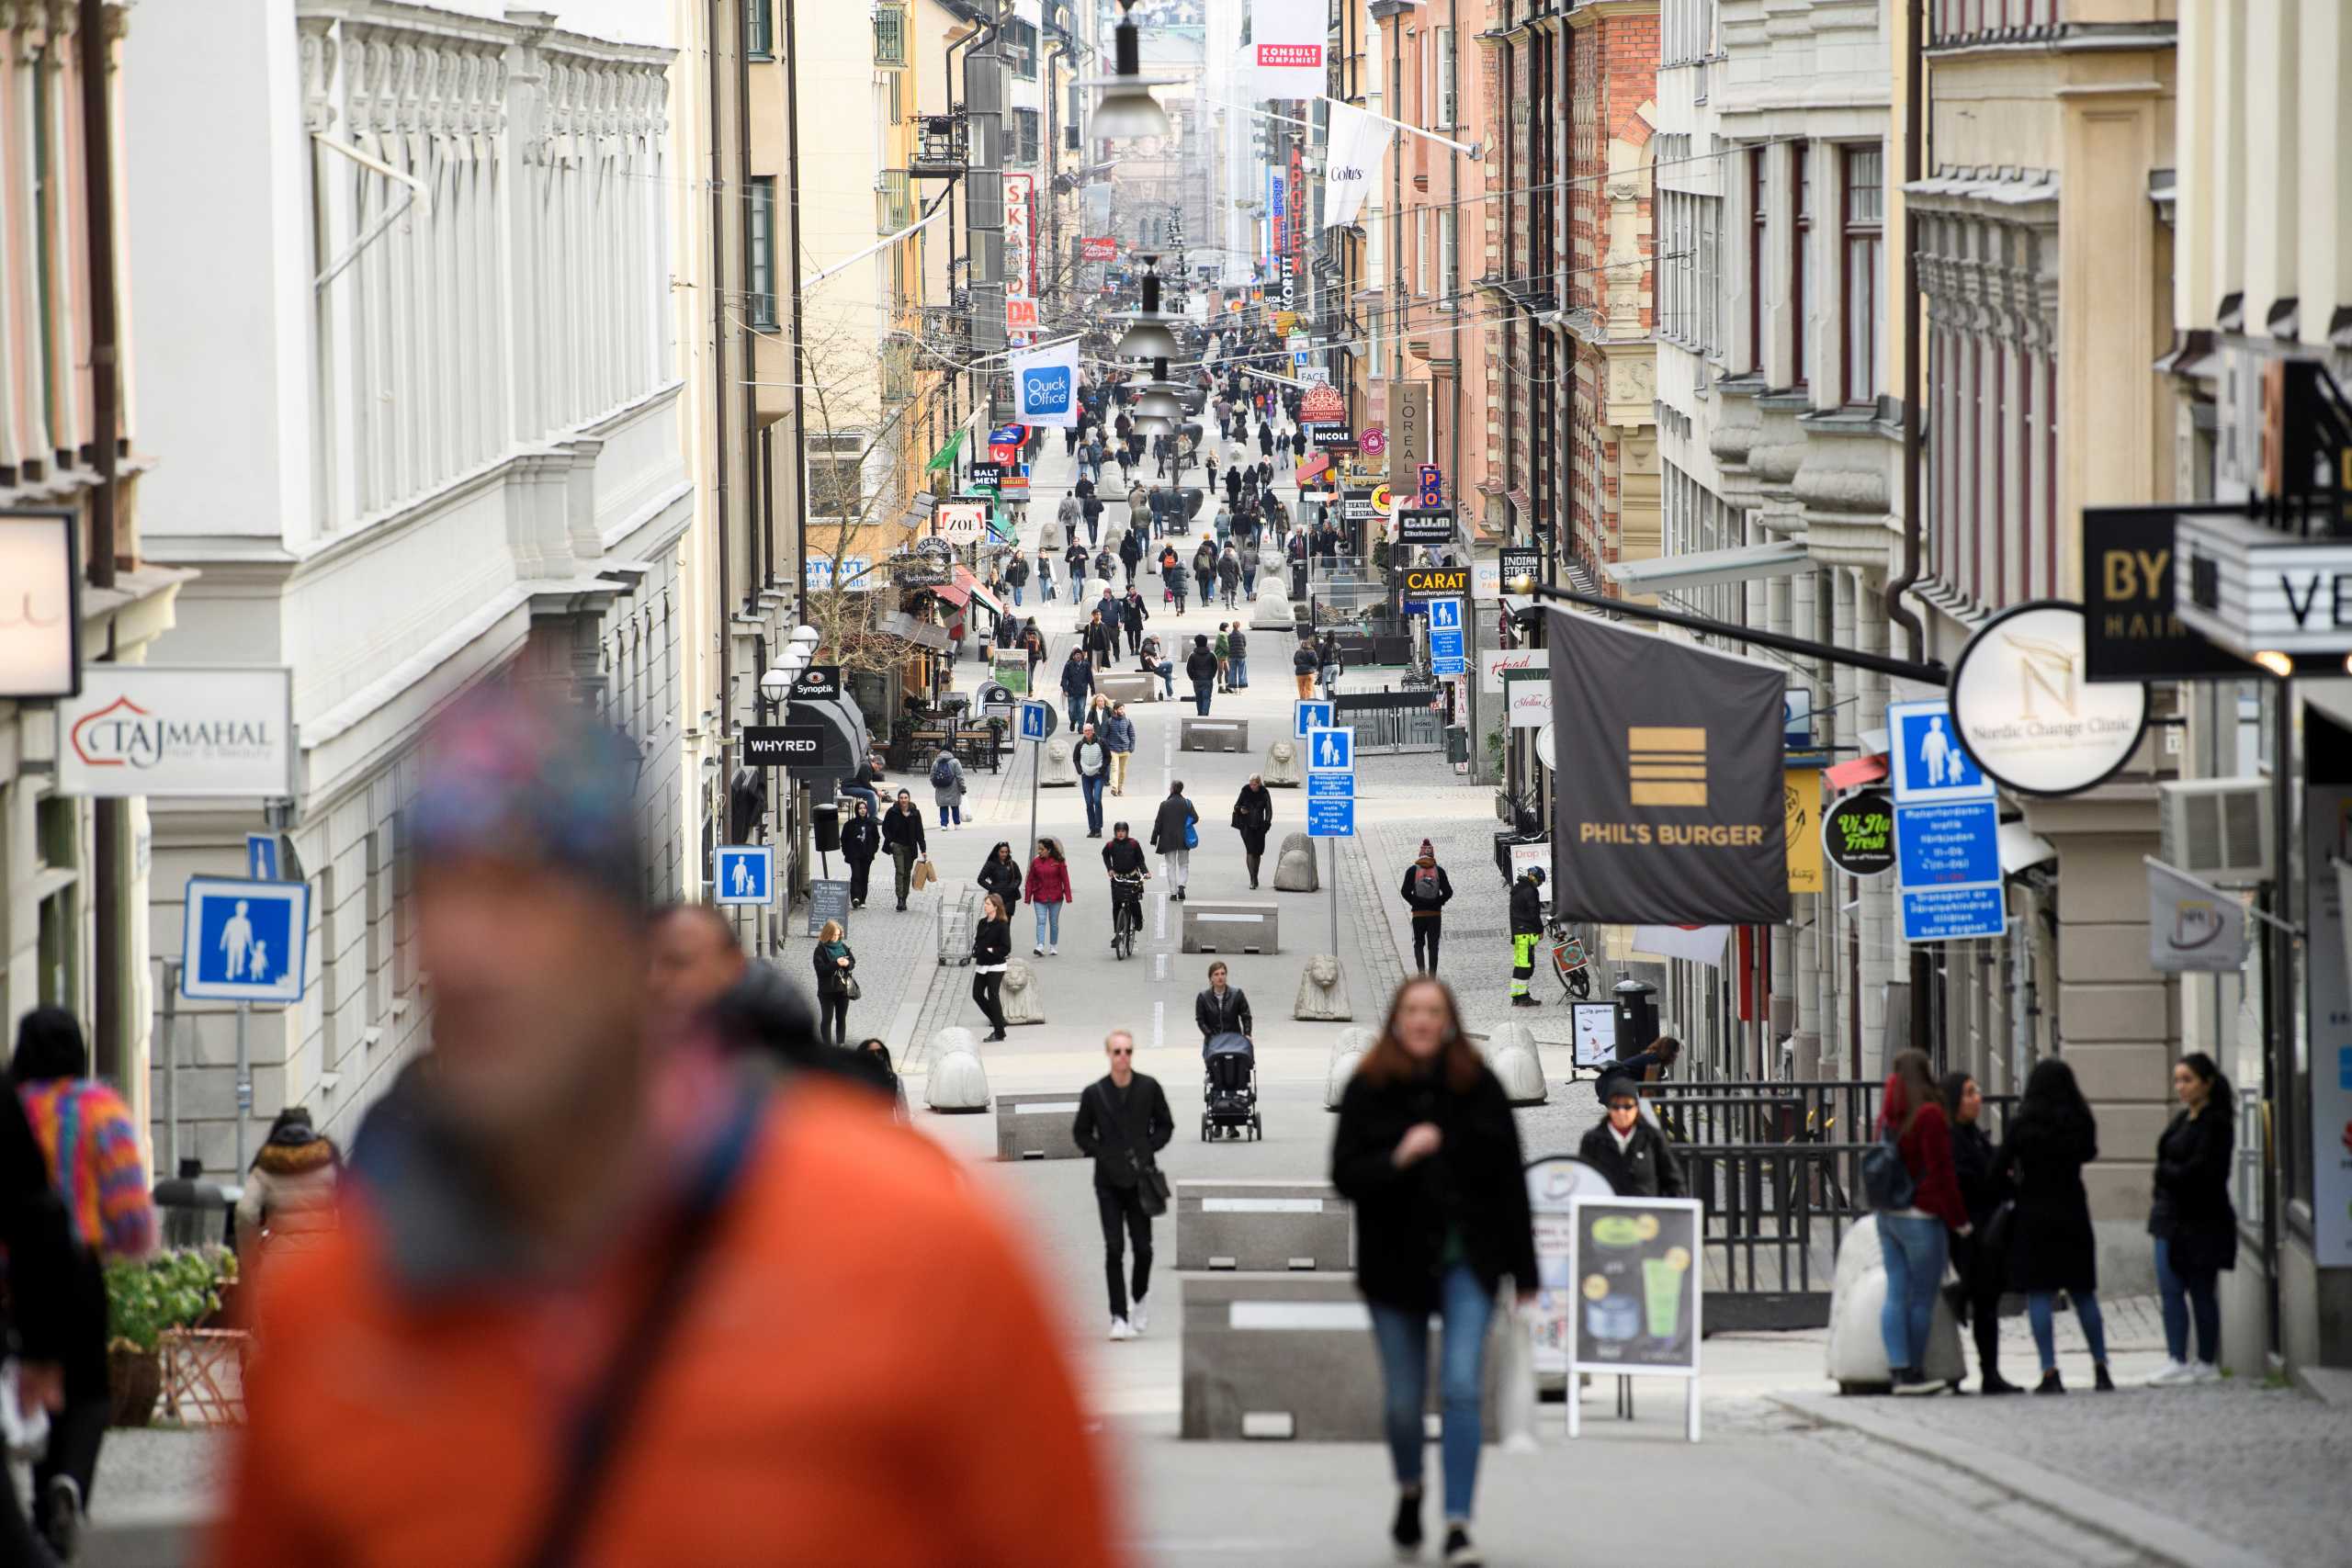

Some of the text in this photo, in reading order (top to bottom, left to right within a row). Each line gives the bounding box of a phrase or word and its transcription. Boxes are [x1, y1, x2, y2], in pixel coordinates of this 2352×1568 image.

[1262, 48, 1316, 56] KONSULT
[1291, 147, 1303, 275] APOTEK
[1028, 377, 1066, 392] Quick
[1029, 392, 1066, 406] Office
[1504, 557, 1538, 566] INDIAN
[1504, 567, 1538, 575] STREET
[2104, 549, 2170, 600] BY
[1408, 572, 1466, 589] CARAT
[797, 685, 833, 694] Synoptik
[165, 721, 272, 746] MAHAL
[1973, 716, 2133, 740] Nordic Change Clinic
[752, 740, 816, 751] WHYRED
[1579, 823, 1763, 846] PHIL'S BURGER
